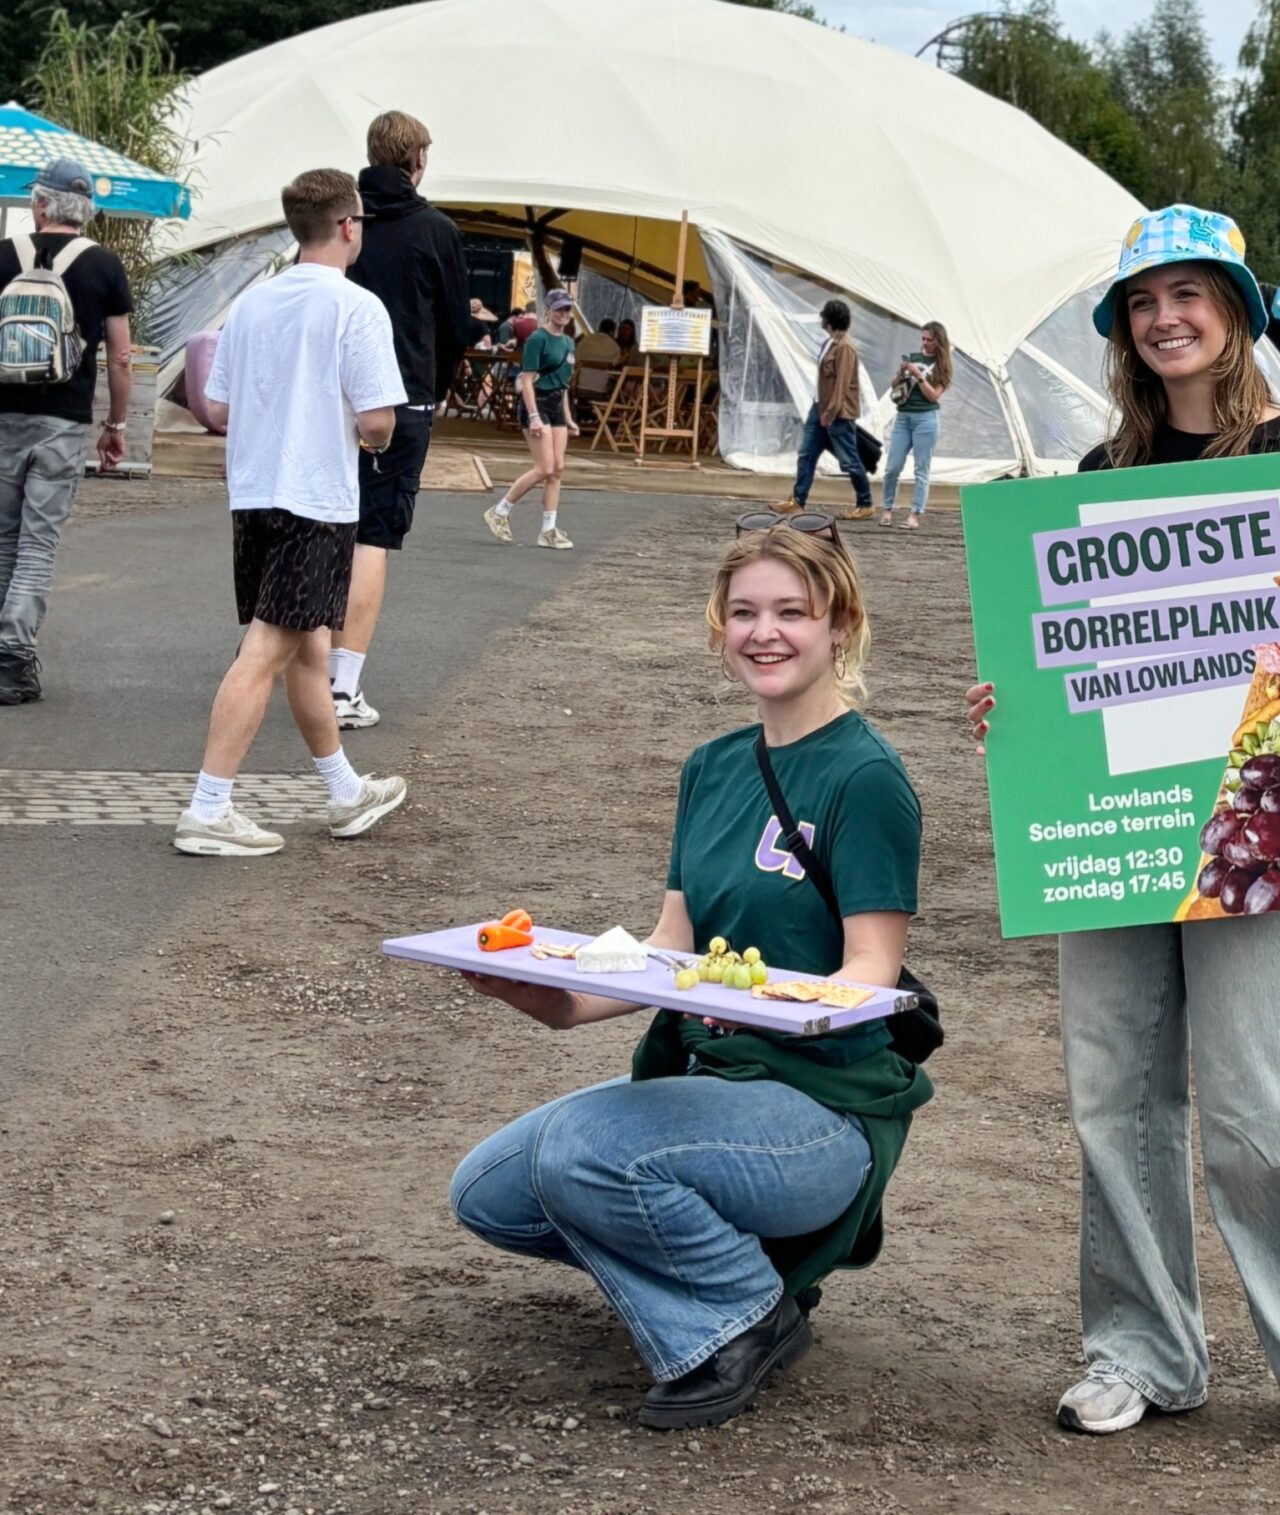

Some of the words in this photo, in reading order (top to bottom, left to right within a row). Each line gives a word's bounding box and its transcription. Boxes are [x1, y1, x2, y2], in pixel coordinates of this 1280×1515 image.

[1047, 510, 1276, 586] GROOTSTE
[1042, 596, 1280, 654] BORRELPLANK
[1071, 671, 1122, 702] VAN
[1127, 649, 1256, 694] LOWLANDS
[1088, 784, 1193, 812] Lowlands
[1028, 819, 1117, 842] Science
[1121, 808, 1195, 833] terrein
[1044, 854, 1121, 880] vrijdag
[1125, 846, 1183, 870] 12:30
[1043, 879, 1124, 903] zondag
[1129, 871, 1186, 894] 17:45
